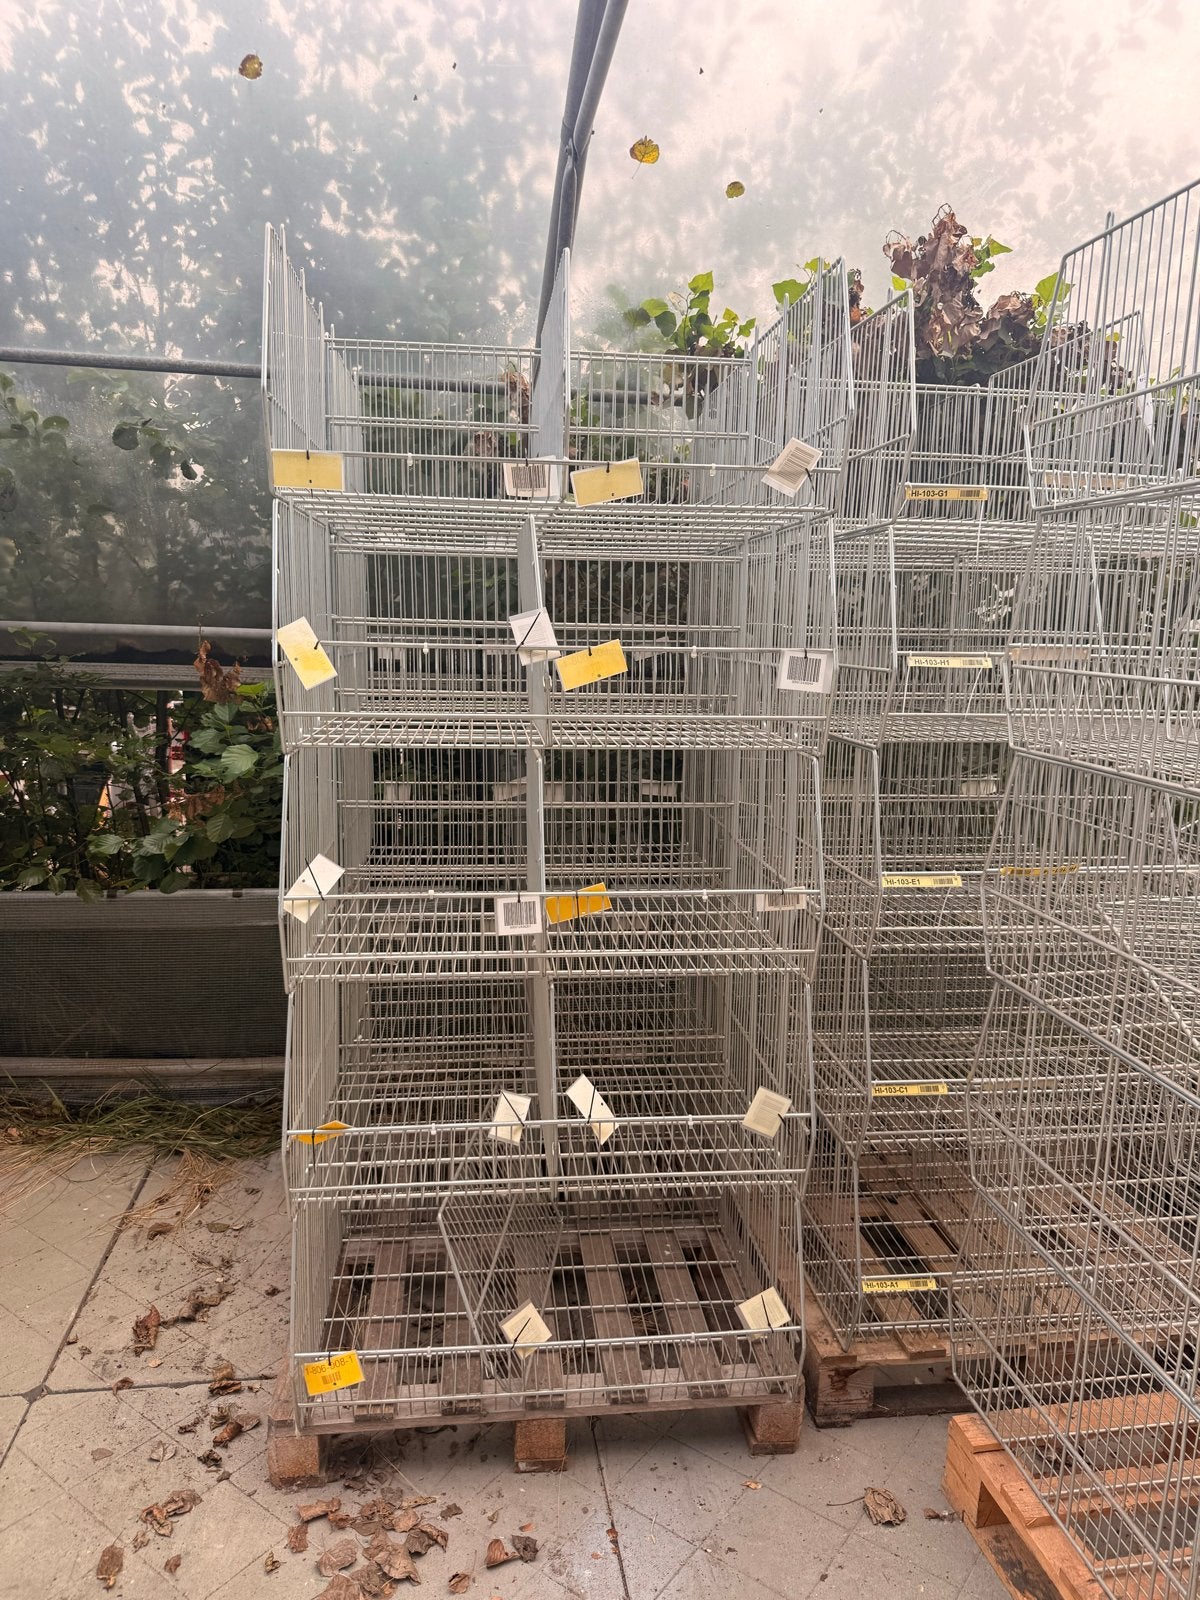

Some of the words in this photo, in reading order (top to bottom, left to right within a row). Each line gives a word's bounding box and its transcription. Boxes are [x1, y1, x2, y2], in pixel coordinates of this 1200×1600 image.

[911, 490, 948, 498] HI-103-G1
[886, 878, 921, 886] HI-103-E1
[874, 1086, 908, 1094] HI-103-C1
